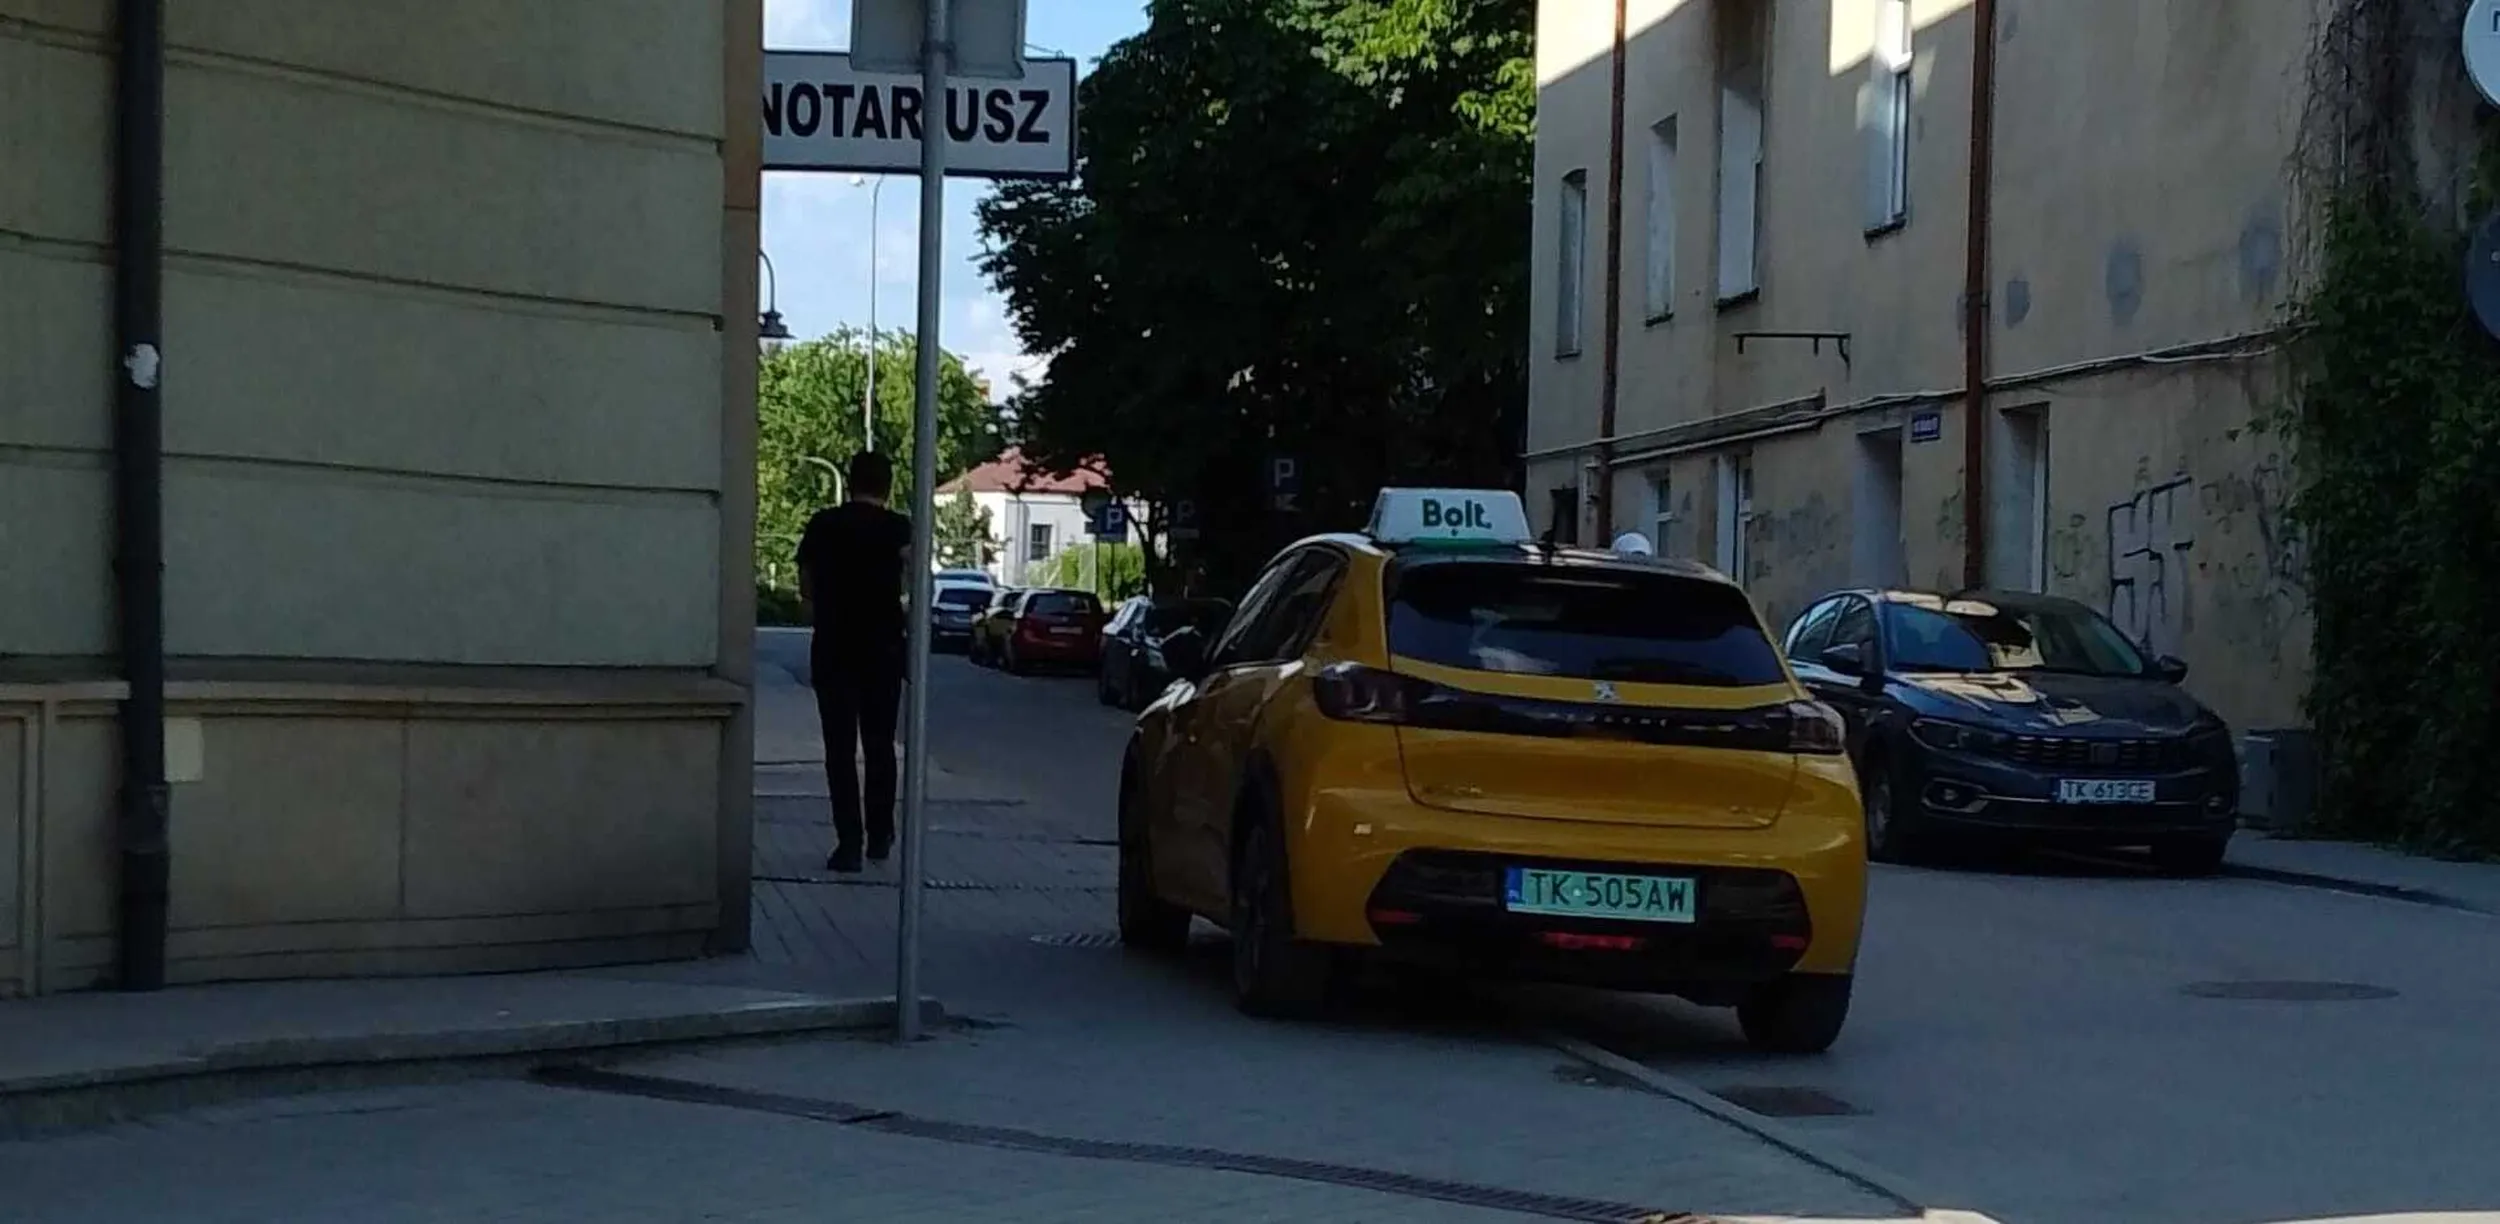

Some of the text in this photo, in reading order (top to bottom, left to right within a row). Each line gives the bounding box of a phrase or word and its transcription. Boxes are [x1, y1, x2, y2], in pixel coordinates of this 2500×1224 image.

[763, 82, 1050, 143] NOTARUSZ
[1274, 458, 1294, 487] P
[1107, 508, 1123, 530] P
[1530, 872, 1685, 912] TK 505AW
